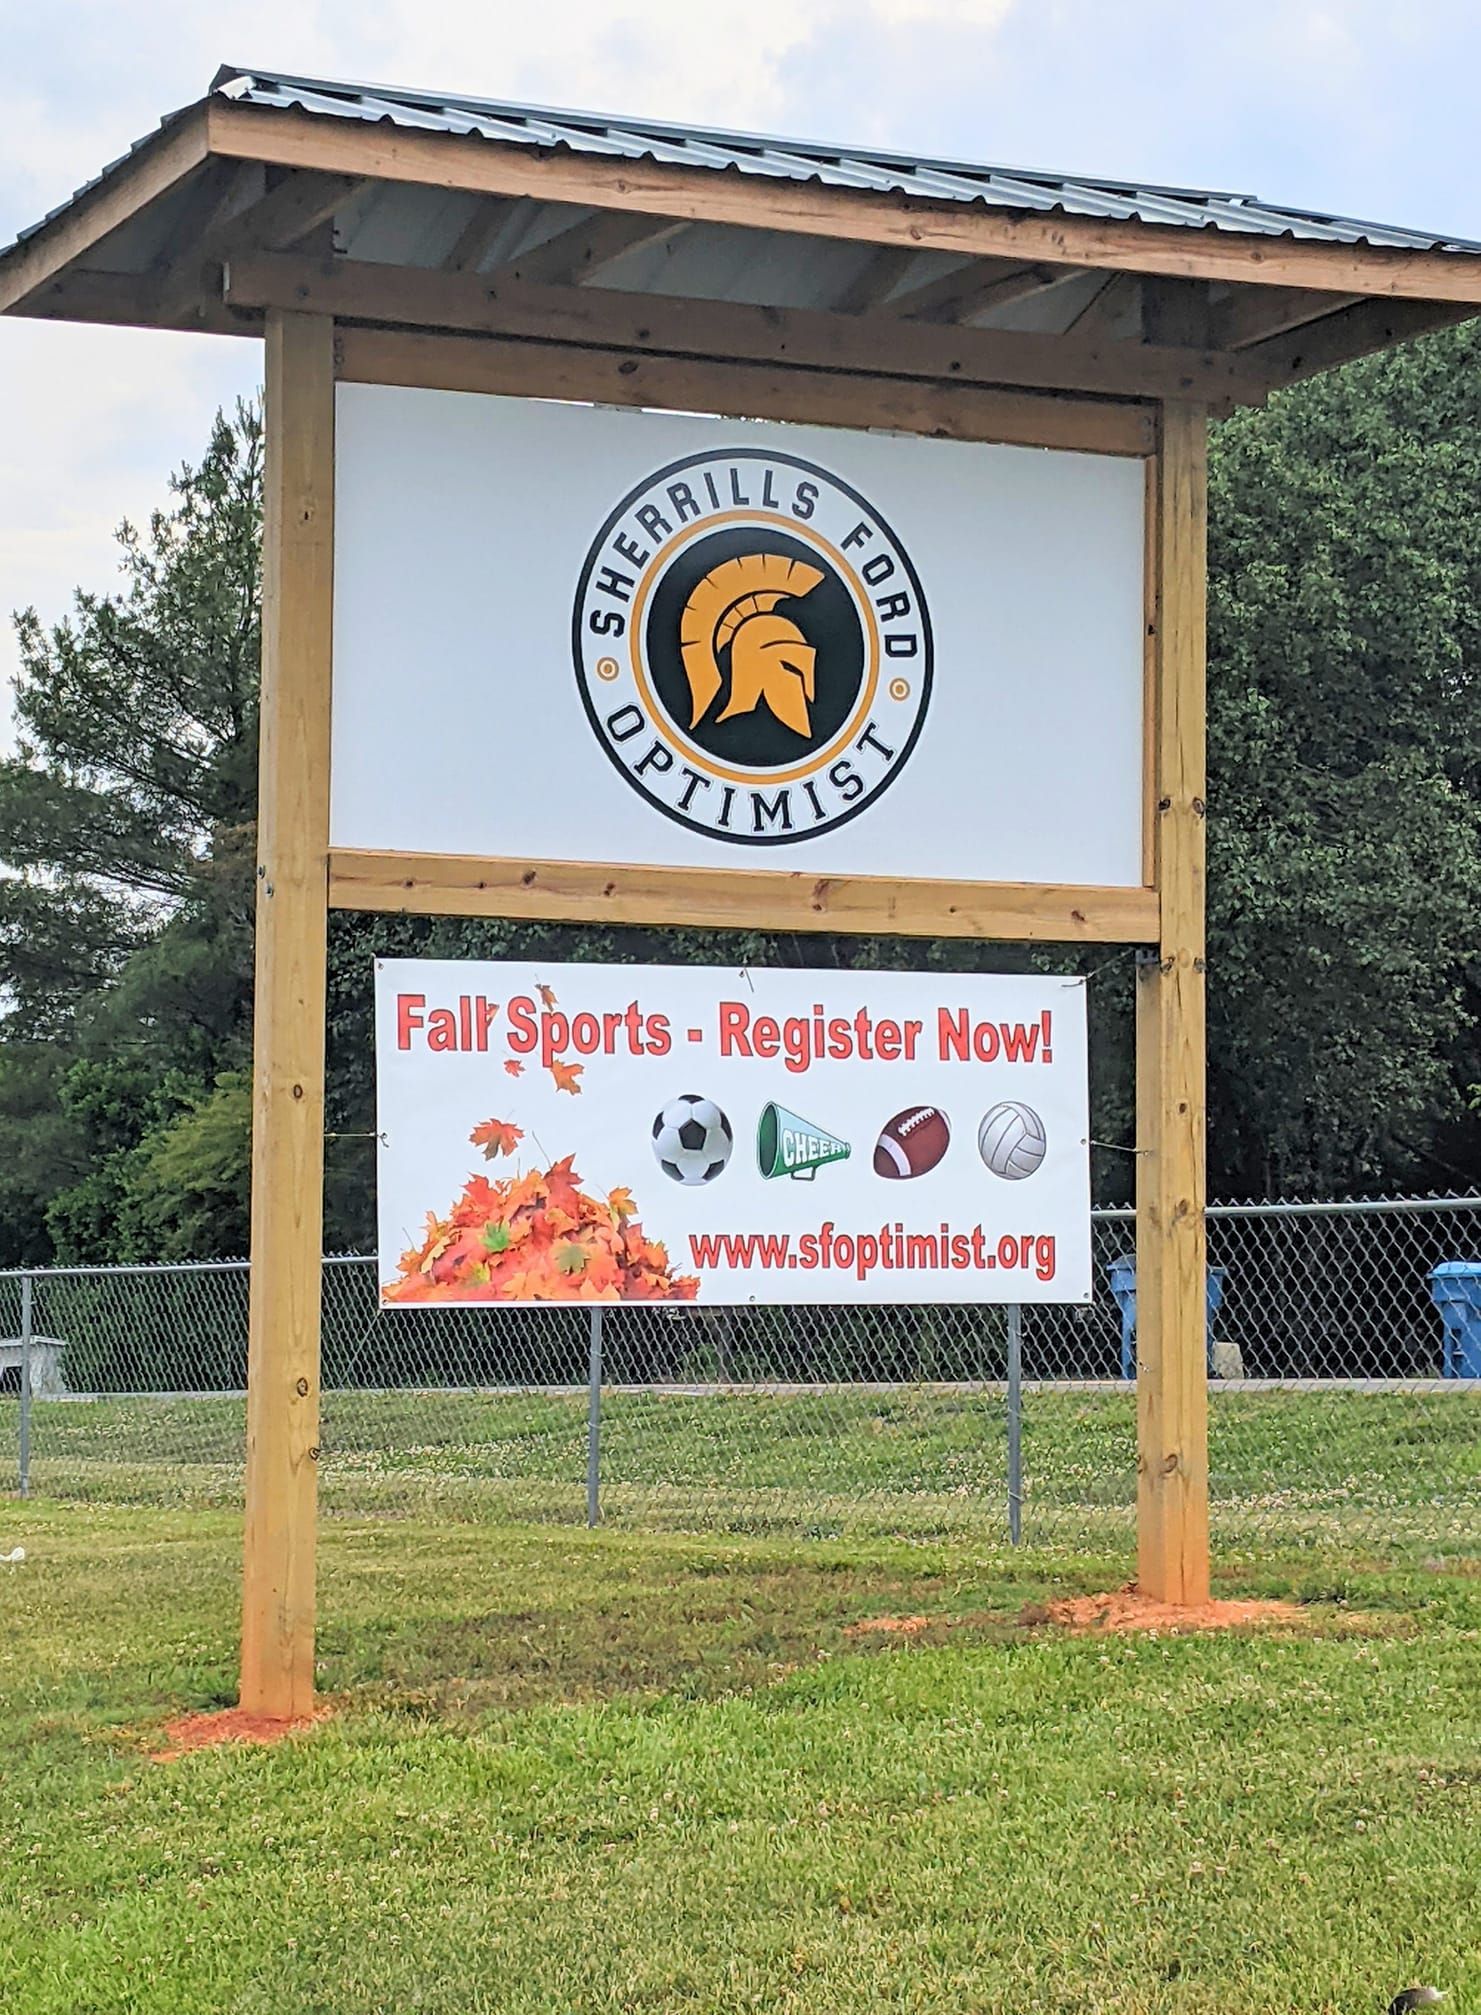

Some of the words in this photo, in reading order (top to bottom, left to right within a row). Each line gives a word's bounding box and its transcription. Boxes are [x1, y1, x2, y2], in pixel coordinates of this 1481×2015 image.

[589, 467, 820, 638] SHERRILLS
[840, 521, 918, 658] FORD
[606, 704, 895, 832] OPTIMIST
[396, 993, 489, 1052] Fall
[506, 995, 672, 1068] Sports
[687, 1028, 704, 1043] -
[718, 1001, 923, 1074] Register
[937, 1006, 1053, 1064] Now!
[782, 1127, 842, 1168] CHEER
[688, 1222, 1057, 1282] www.sfoptimist.org
